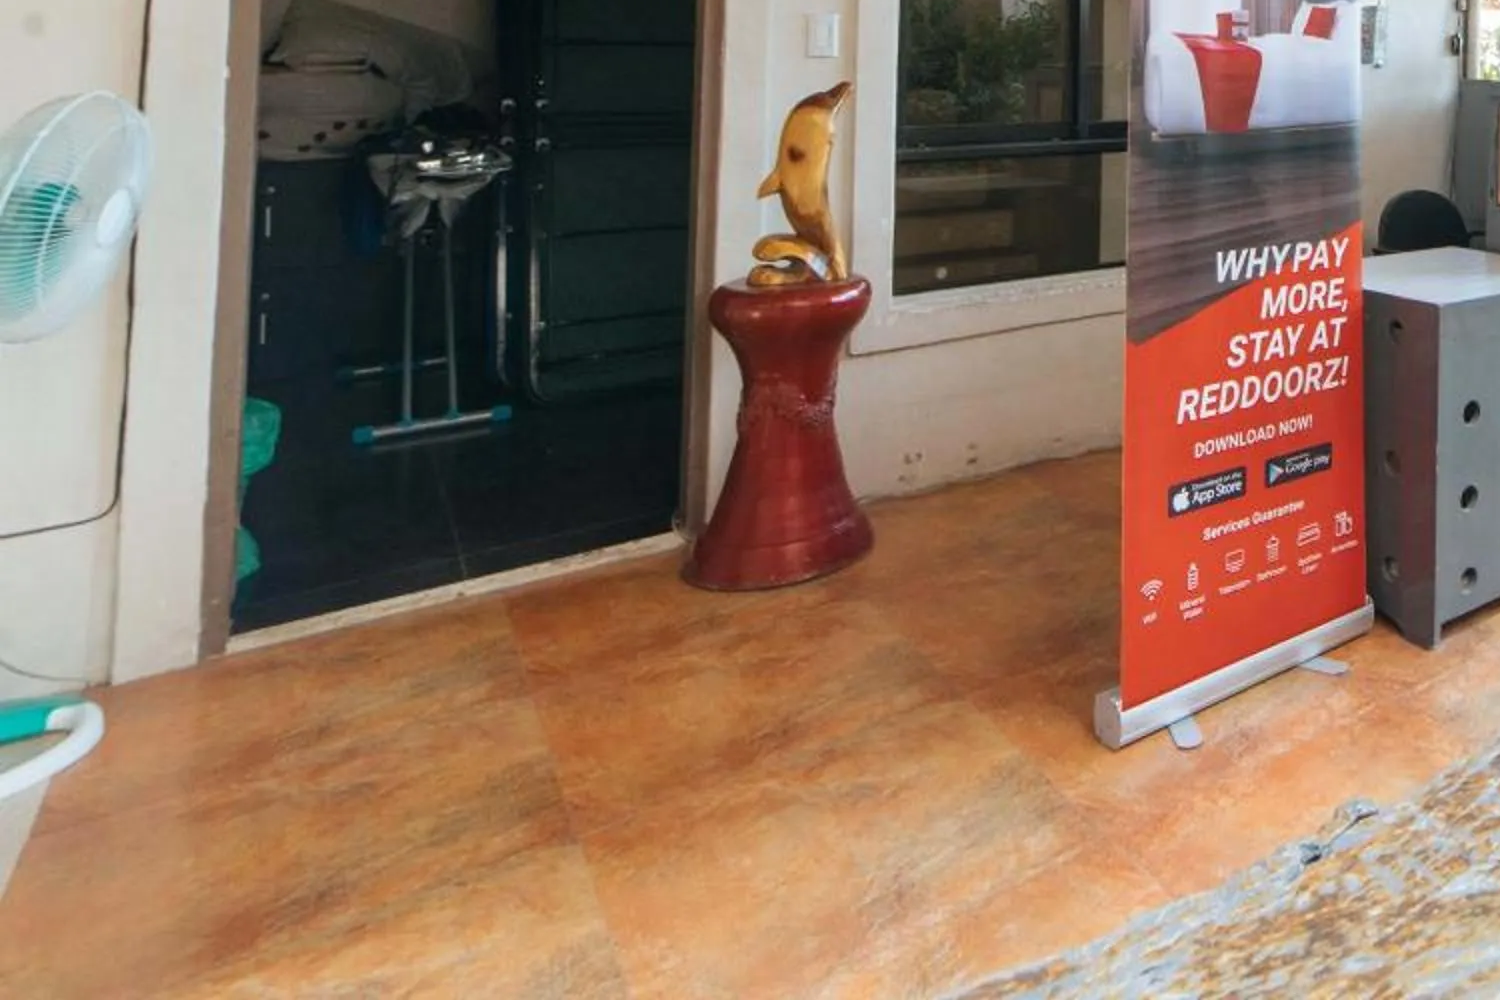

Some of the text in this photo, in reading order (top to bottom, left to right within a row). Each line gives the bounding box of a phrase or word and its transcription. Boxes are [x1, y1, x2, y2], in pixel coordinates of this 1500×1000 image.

[1216, 236, 1349, 283] WHY PAY
[1260, 277, 1348, 319] MORE,
[1227, 317, 1348, 368] STAY AT
[1176, 355, 1349, 425] REDDOORZ!
[1193, 413, 1314, 459] DOWNLOAD NOW!
[1191, 480, 1242, 505] App Store
[1202, 515, 1250, 541] Services
